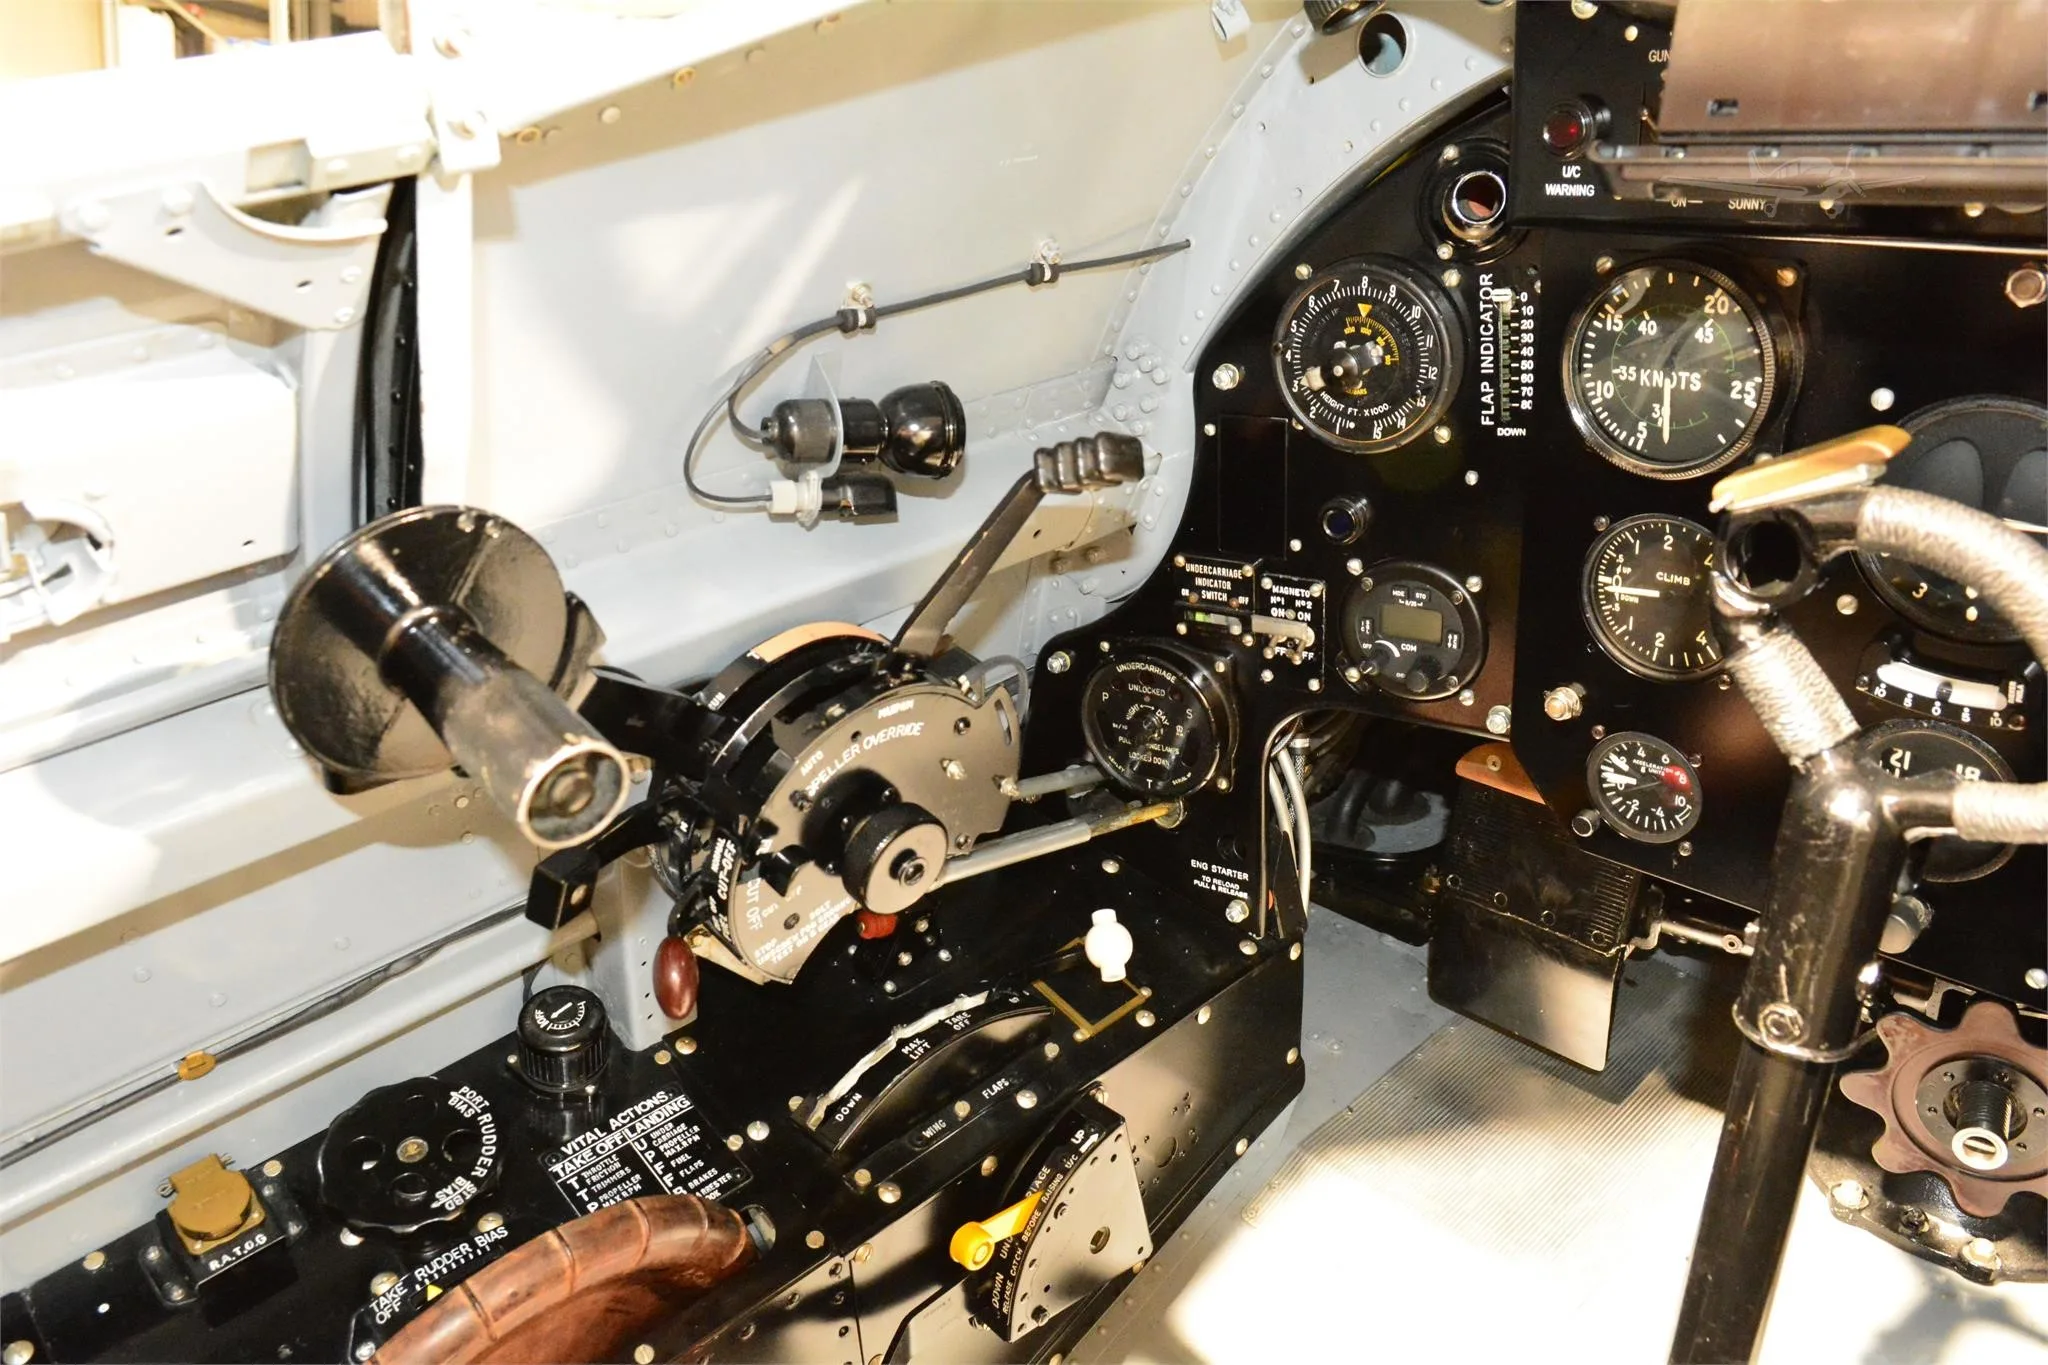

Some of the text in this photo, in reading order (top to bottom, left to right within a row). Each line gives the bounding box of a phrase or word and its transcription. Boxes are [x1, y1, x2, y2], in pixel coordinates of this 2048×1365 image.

[1562, 166, 1582, 178] U/C
[1545, 183, 1594, 196] WARNING
[1334, 280, 1340, 293] 7
[1361, 276, 1368, 289] 8
[1389, 285, 1396, 297] 9
[1520, 292, 1528, 302] 0
[1308, 296, 1315, 307] 6
[1704, 295, 1729, 314] 20
[1411, 305, 1421, 319] 10
[1520, 306, 1534, 315] 10
[1290, 320, 1297, 332] 5
[1520, 320, 1534, 329] 20
[1606, 314, 1624, 332] 15
[1638, 320, 1657, 336] 40
[1426, 335, 1434, 348] 11
[1520, 333, 1534, 343] 30
[1694, 328, 1714, 344] 45
[1285, 350, 1292, 362] 4
[1480, 272, 1494, 426] FLAP INDICATOR
[1520, 347, 1534, 356] 40
[1520, 360, 1534, 370] 50
[1426, 366, 1438, 380] 12
[1520, 374, 1534, 383] 60
[1619, 366, 1636, 381] 35
[1292, 380, 1299, 392] 3
[1520, 387, 1534, 396] 70
[1596, 381, 1614, 399] 10
[1730, 381, 1756, 400] 25
[1320, 390, 1344, 412] HEIGHT
[1520, 400, 1534, 410] 80
[1308, 407, 1316, 419] 2
[1396, 417, 1406, 429] 14
[1636, 421, 1647, 439] 5
[1373, 426, 1382, 440] 15
[1497, 427, 1526, 437] DOWN
[1664, 535, 1673, 551] 2
[1185, 563, 1242, 579] UNDERCARRIAGE
[1656, 571, 1691, 586] CLIMB
[1195, 577, 1231, 590] INDICATOR
[1202, 590, 1227, 602] SWITCH
[1272, 586, 1311, 598] MAGNETO
[1270, 607, 1285, 618] ON
[1297, 612, 1311, 622] ON
[1655, 632, 1665, 647] 2
[1696, 630, 1707, 646] 4
[1401, 643, 1417, 652] COM
[1116, 662, 1177, 683] UNDERCARRIAGE
[1102, 692, 1109, 701] P
[1129, 683, 1165, 696] UNLOCKED
[1155, 709, 1169, 726] DAY
[1186, 709, 1193, 719] S
[862, 722, 925, 750] OVERRIDE
[1637, 747, 1646, 758] 4
[1661, 754, 1670, 764] 6
[800, 750, 824, 776] AUTO
[1146, 779, 1152, 788] T
[1679, 772, 1687, 784] 8
[1675, 795, 1686, 806] 10
[718, 839, 736, 900] CUT-OFF
[1190, 859, 1249, 881] ENG STARTER
[1194, 879, 1210, 889] PULL
[1218, 885, 1248, 899] RELEASE
[1202, 875, 1240, 890] TO RELOAD
[945, 1011, 972, 1027] TAKE
[952, 1018, 971, 1031] OFF
[909, 1041, 931, 1061] LIFT
[458, 1086, 490, 1109] PORT
[448, 1098, 476, 1118] BIAS
[835, 1092, 863, 1123] DOWN
[922, 1078, 1010, 1138] WING FLAPS
[627, 1098, 691, 1139] LANDING
[650, 1122, 674, 1139] UNDER
[652, 1122, 688, 1147] CARRIAGE
[1070, 1129, 1085, 1145] UP
[471, 1112, 497, 1178] RUDDER
[560, 1127, 608, 1157] VITAL
[634, 1138, 648, 1151] U
[659, 1125, 700, 1152] PROPELLER
[552, 1132, 624, 1178] TAKE OFF
[644, 1150, 655, 1163] P
[670, 1153, 692, 1167] FUEL
[581, 1154, 620, 1178] THROTTLE
[586, 1161, 622, 1186] FRICTION
[653, 1161, 665, 1175] F
[679, 1160, 704, 1178] FLAPS
[566, 1176, 580, 1190] T
[591, 1166, 631, 1192] TRIMMERS
[662, 1173, 674, 1187] F
[688, 1168, 718, 1189] BRAKES
[435, 1176, 467, 1201] BIAS
[444, 1180, 478, 1210] STBD
[576, 1188, 589, 1202] T
[598, 1174, 642, 1202] PROPELLER
[586, 1202, 599, 1213] P
[602, 1195, 622, 1208] MAX
[1003, 1154, 1079, 1314] RELEASE CATCH BEFORE RAISING U/C
[414, 1226, 509, 1281] RUDDER BIAS
[369, 1281, 409, 1313] TAKE
[991, 1272, 1004, 1309] DOWN
[375, 1299, 401, 1325] OFF
